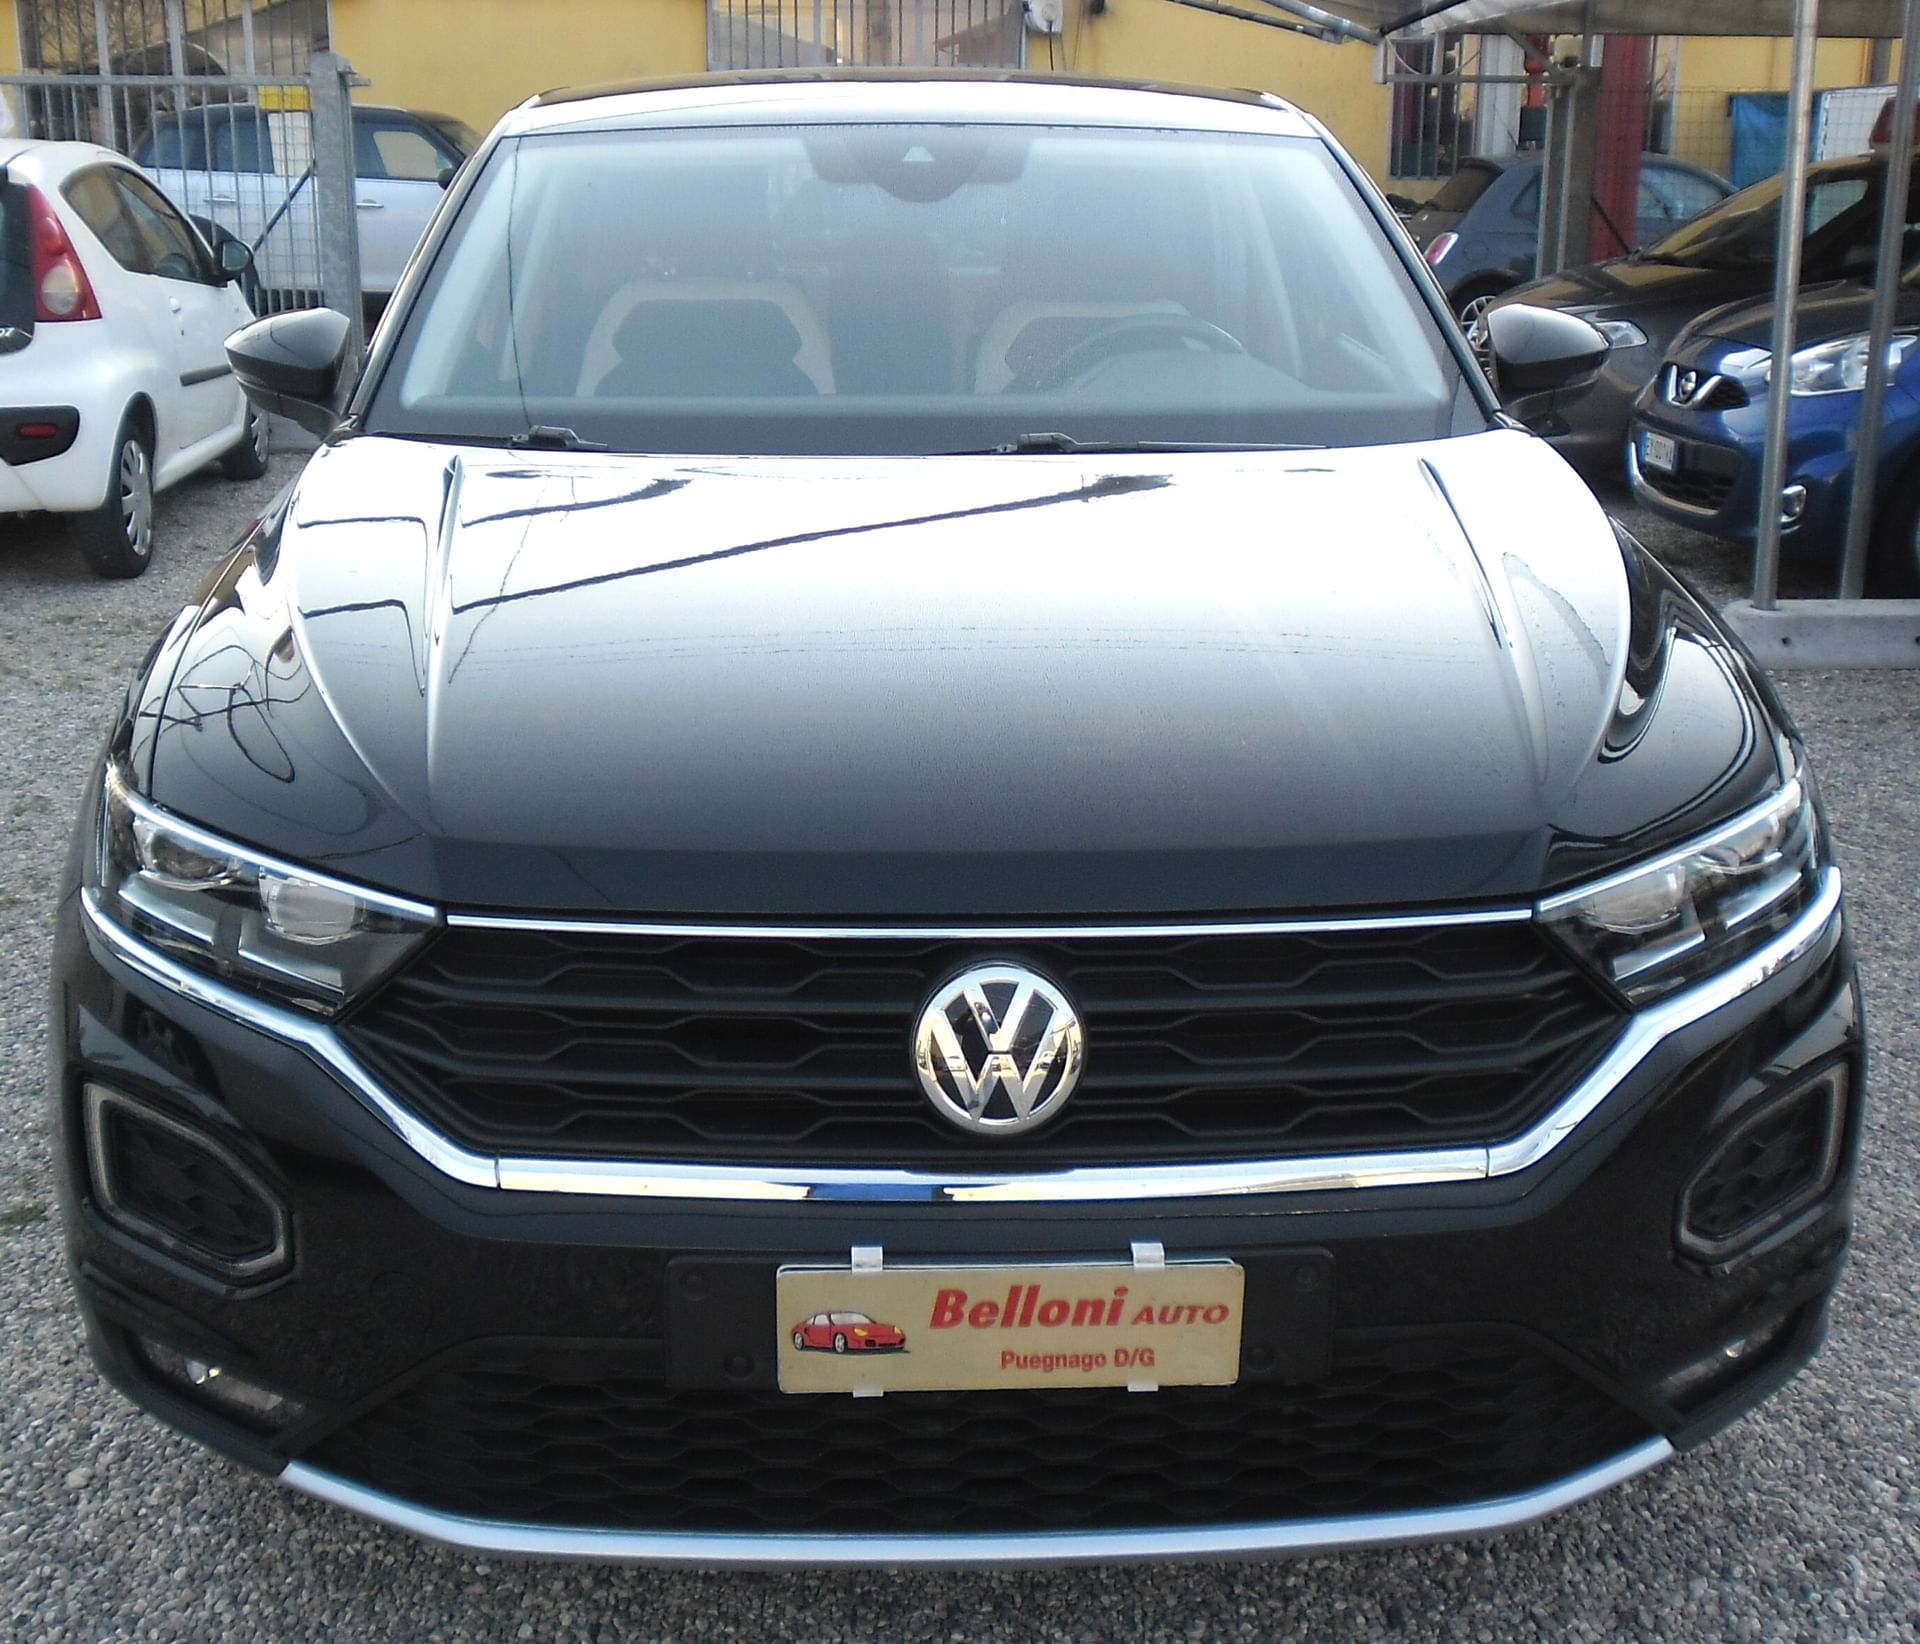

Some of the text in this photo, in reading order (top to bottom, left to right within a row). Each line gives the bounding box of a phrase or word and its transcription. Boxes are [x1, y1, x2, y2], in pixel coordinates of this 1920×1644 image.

[922, 972, 1075, 1126] VW
[929, 1284, 1231, 1329] Belloni AUTO
[1000, 1347, 1156, 1373] Puegnago D/G
